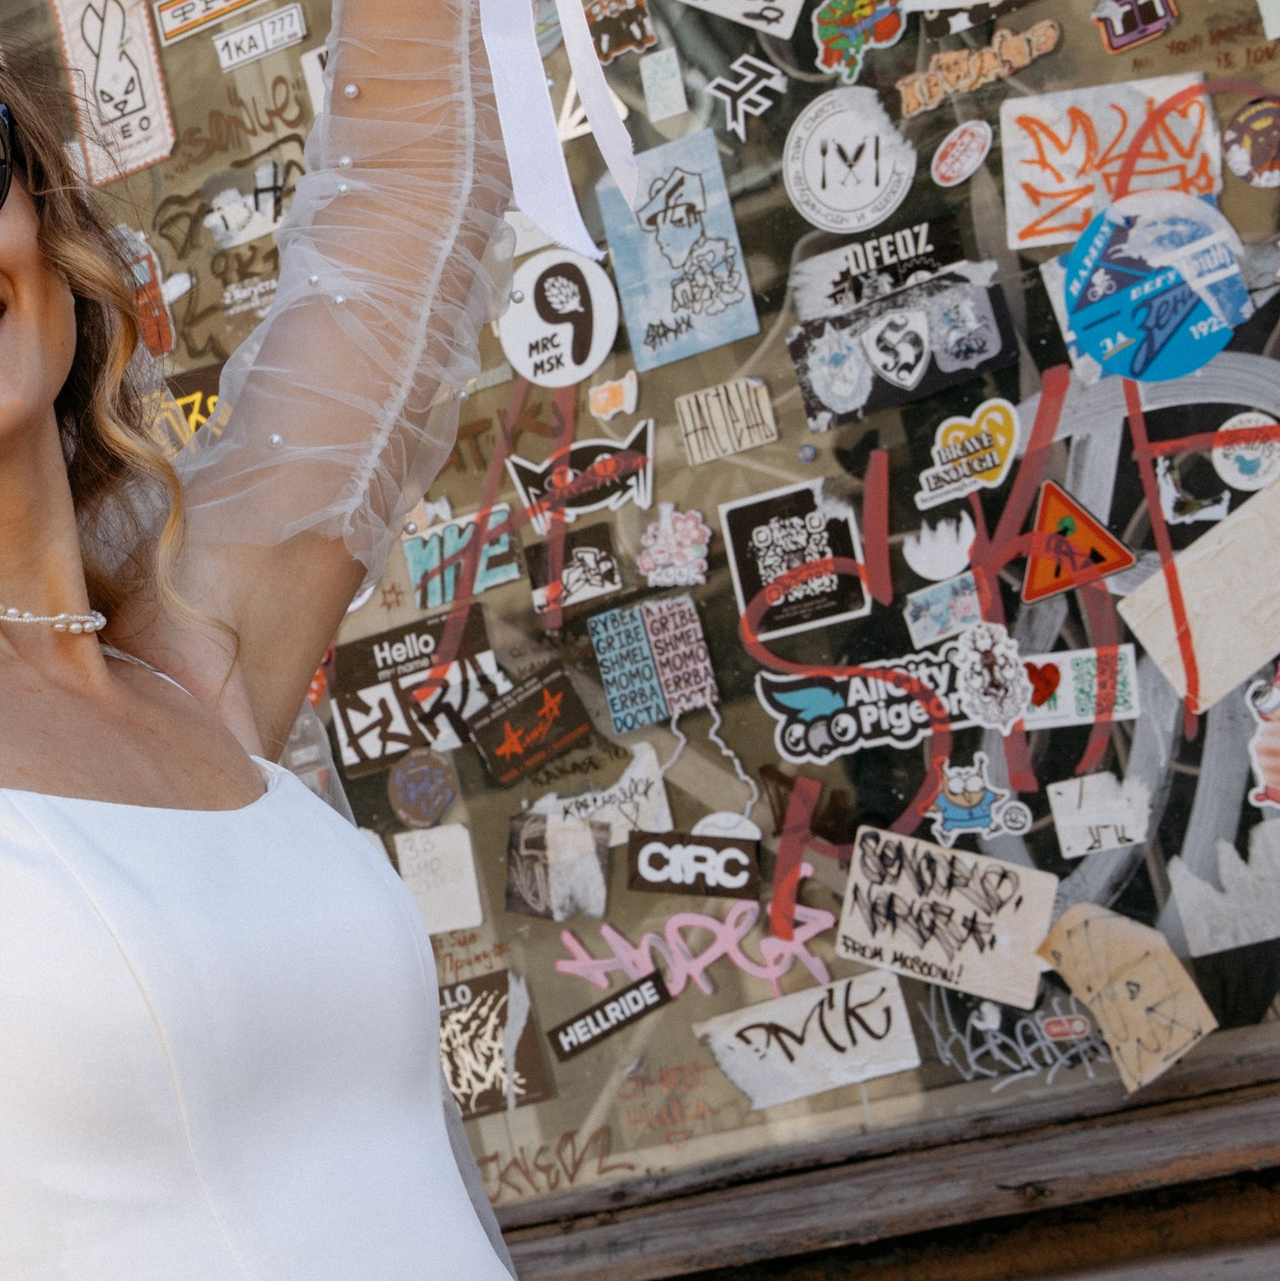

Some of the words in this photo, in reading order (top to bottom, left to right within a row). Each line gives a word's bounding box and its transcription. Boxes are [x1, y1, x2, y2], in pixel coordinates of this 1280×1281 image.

[528, 331, 561, 358] MRC
[533, 351, 566, 378] MSK
[937, 431, 995, 466] BRAVE
[926, 450, 1003, 492] ENOUGH
[373, 632, 436, 669] Hello
[600, 646, 649, 675] SHMEL
[658, 645, 708, 676] MOMO
[605, 663, 654, 695] MOMO
[610, 684, 659, 713] ERRBA
[637, 841, 750, 889] CIRC
[557, 980, 661, 1053] HELLRIDE
